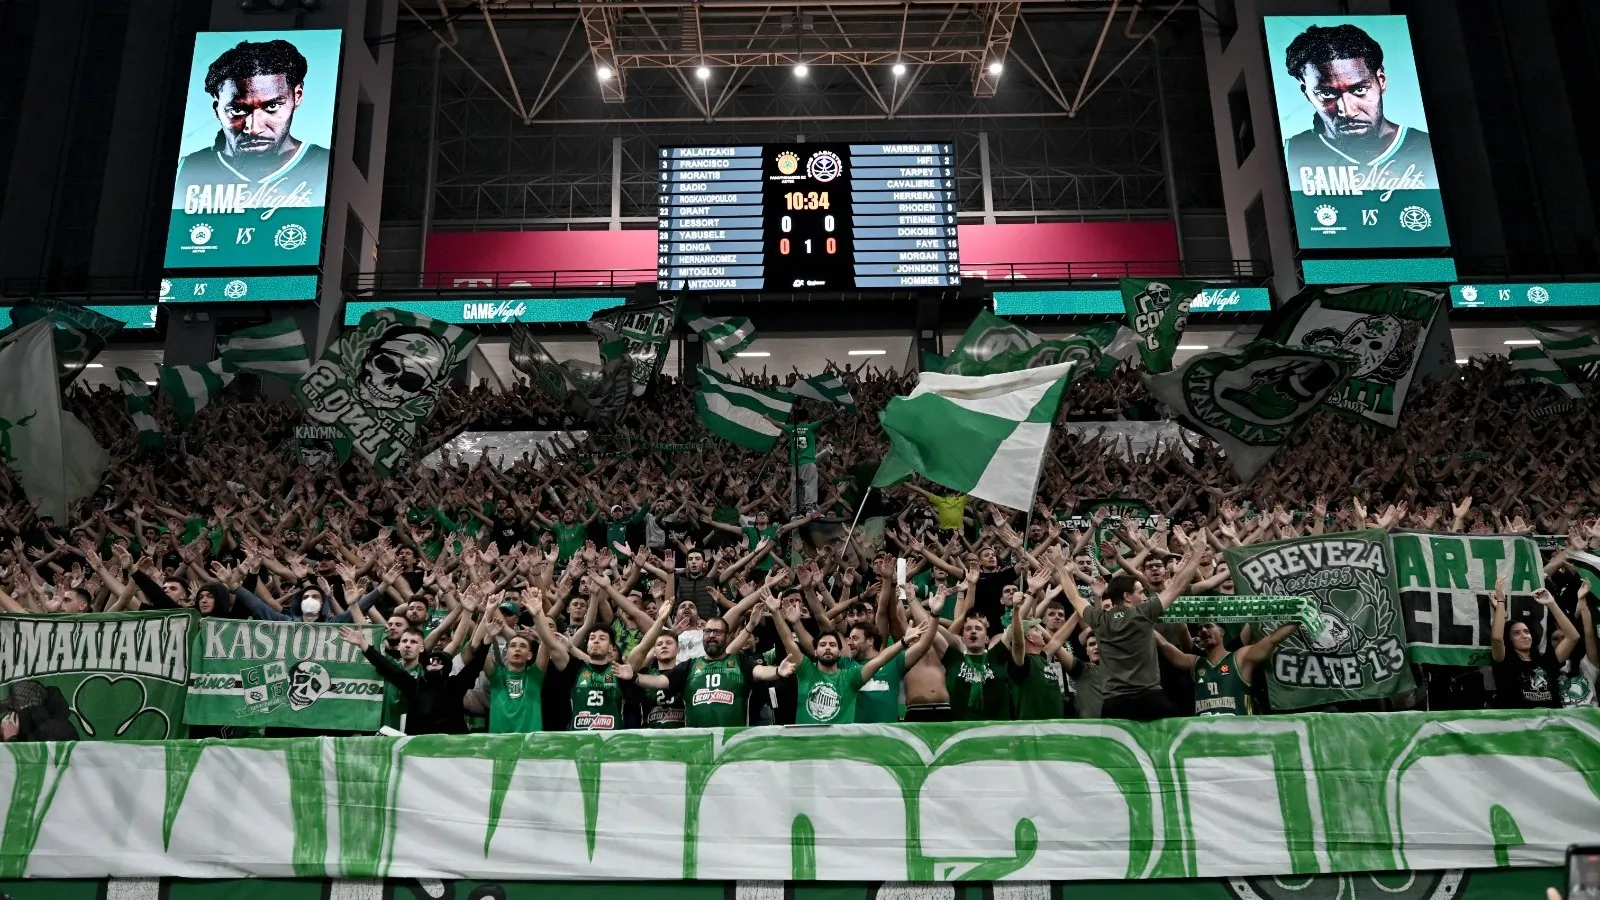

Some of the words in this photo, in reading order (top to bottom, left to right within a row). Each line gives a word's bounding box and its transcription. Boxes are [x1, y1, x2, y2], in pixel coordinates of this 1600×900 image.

[680, 148, 734, 156] KALAITZAKIS
[882, 146, 920, 154] WARREN
[680, 160, 729, 168] FRANCISCO
[680, 171, 720, 180] MORAITIS
[900, 168, 934, 176] TARPEY
[887, 180, 935, 188] CAVALIERE
[1300, 166, 1364, 196] GAME
[1355, 160, 1426, 202] Night
[680, 183, 706, 192] BADIO
[184, 184, 248, 214] GAME
[240, 178, 313, 220] Night
[680, 195, 737, 203] ROGKAVOPOULOS
[894, 192, 935, 200] HERRERA
[784, 192, 830, 210] 10:34
[680, 206, 710, 215] GRANT
[900, 204, 935, 212] RHODEN
[900, 215, 936, 224] ETIENNE
[1362, 209, 1379, 226] VS
[680, 218, 720, 227] LESSORT
[782, 216, 792, 232] 0
[825, 215, 835, 232] 0
[236, 228, 255, 244] VS
[680, 230, 725, 239] YABUSELE
[898, 228, 936, 236] DOKOSSI
[680, 243, 711, 251] BONGA
[780, 238, 790, 254] 0
[805, 239, 811, 253] 1
[826, 238, 836, 254] 0
[916, 240, 939, 248] FAYE
[680, 255, 736, 263] HERNANGOMEZ
[900, 252, 938, 260] MORGAN
[679, 267, 724, 276] MITOGLOU
[897, 264, 939, 272] JOHNSON
[901, 276, 939, 284] HOMMES
[194, 283, 208, 295] VS
[1206, 288, 1240, 311] Night
[1499, 289, 1511, 301] VS
[464, 303, 495, 320] GAME
[491, 300, 527, 322] Night
[1242, 540, 1386, 590] PREVEZA
[1392, 536, 1543, 593] ARTA
[1163, 600, 1298, 616] ANATHINAIKOS
[1275, 654, 1362, 685] GATE
[1367, 638, 1404, 678] 13
[706, 674, 720, 688] 10
[336, 682, 380, 696] 2009
[587, 690, 604, 706] 25
